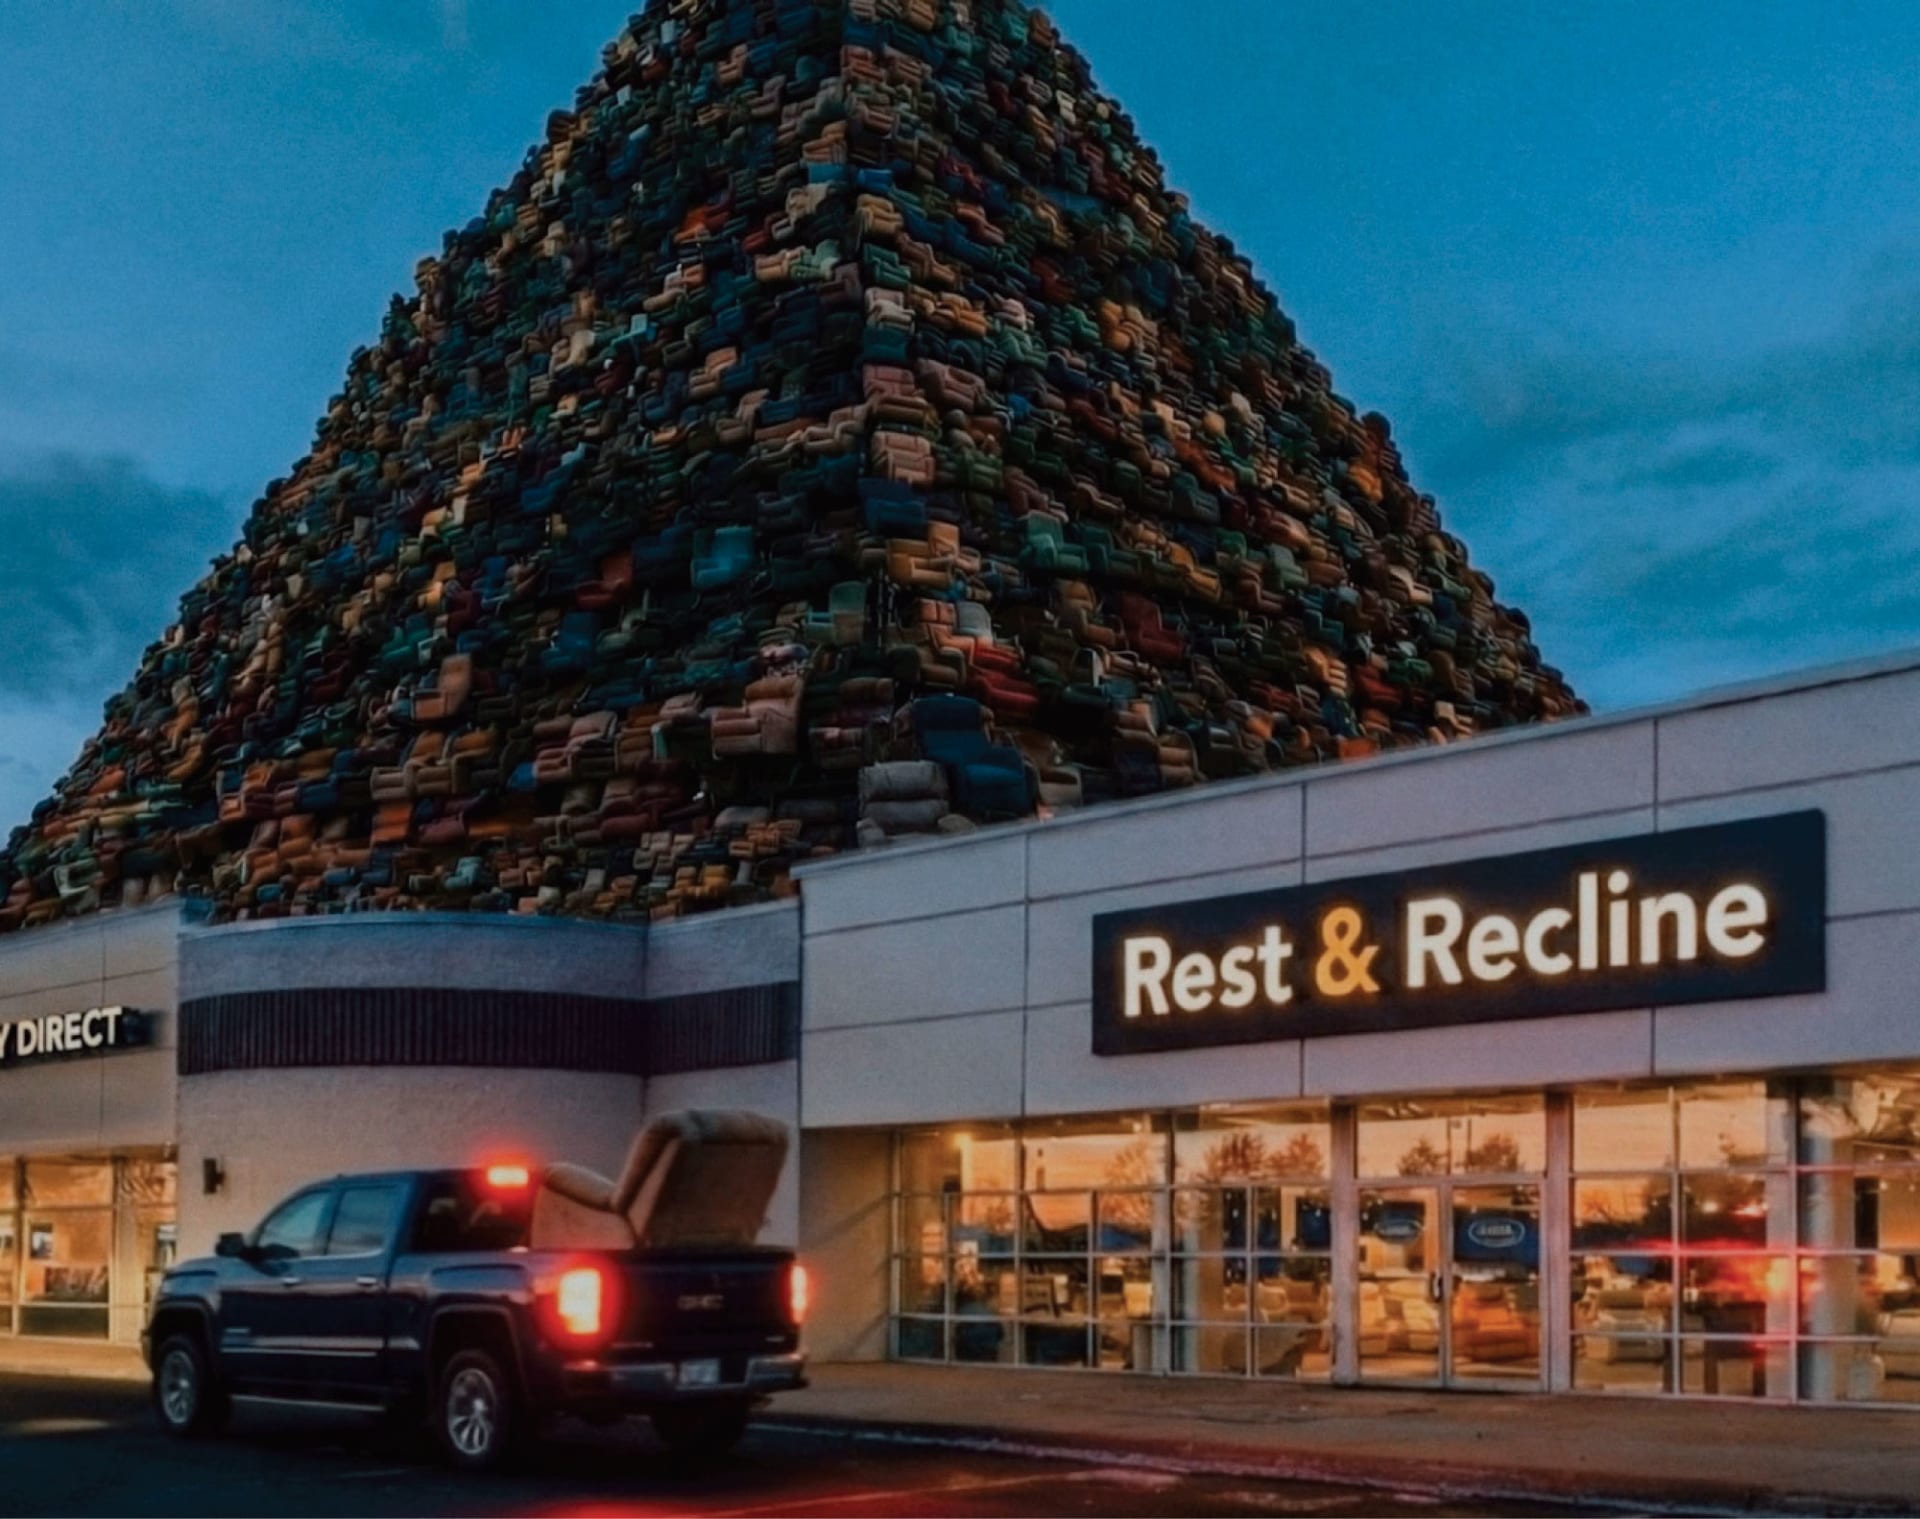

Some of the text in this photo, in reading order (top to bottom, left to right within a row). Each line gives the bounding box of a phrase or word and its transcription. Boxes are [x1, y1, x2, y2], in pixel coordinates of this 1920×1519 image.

[1123, 871, 1767, 1017] Rest & Recline
[17, 1005, 122, 1056] DIRECT
